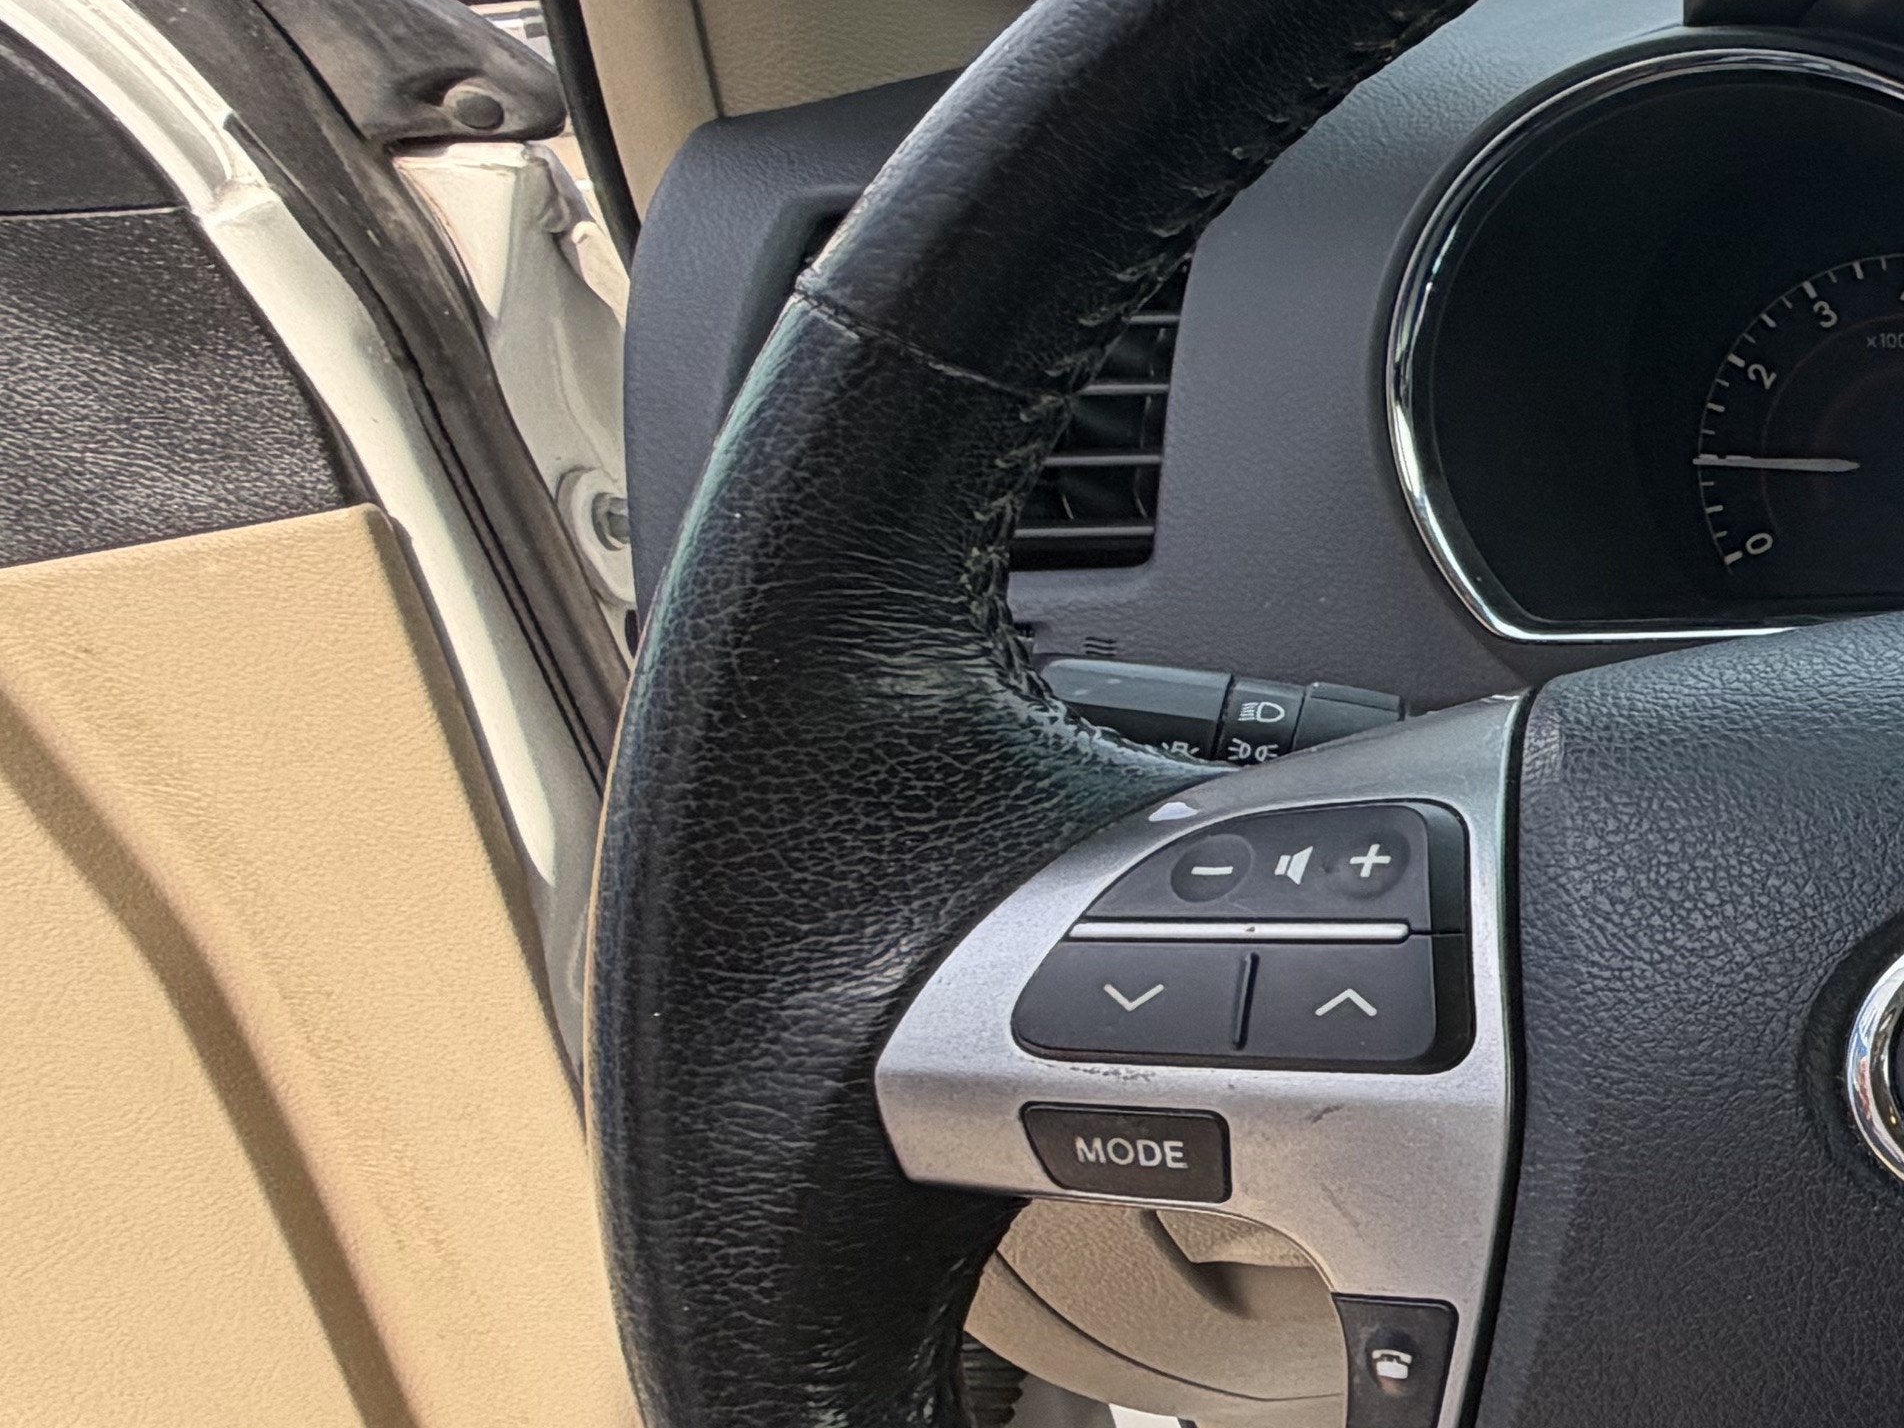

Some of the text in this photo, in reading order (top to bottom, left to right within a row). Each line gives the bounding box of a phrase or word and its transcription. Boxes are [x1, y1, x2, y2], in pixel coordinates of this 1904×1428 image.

[1812, 301, 1838, 328] 3
[1747, 363, 1777, 390] 2
[1745, 532, 1774, 555] 0
[1074, 1136, 1188, 1170] MODE
